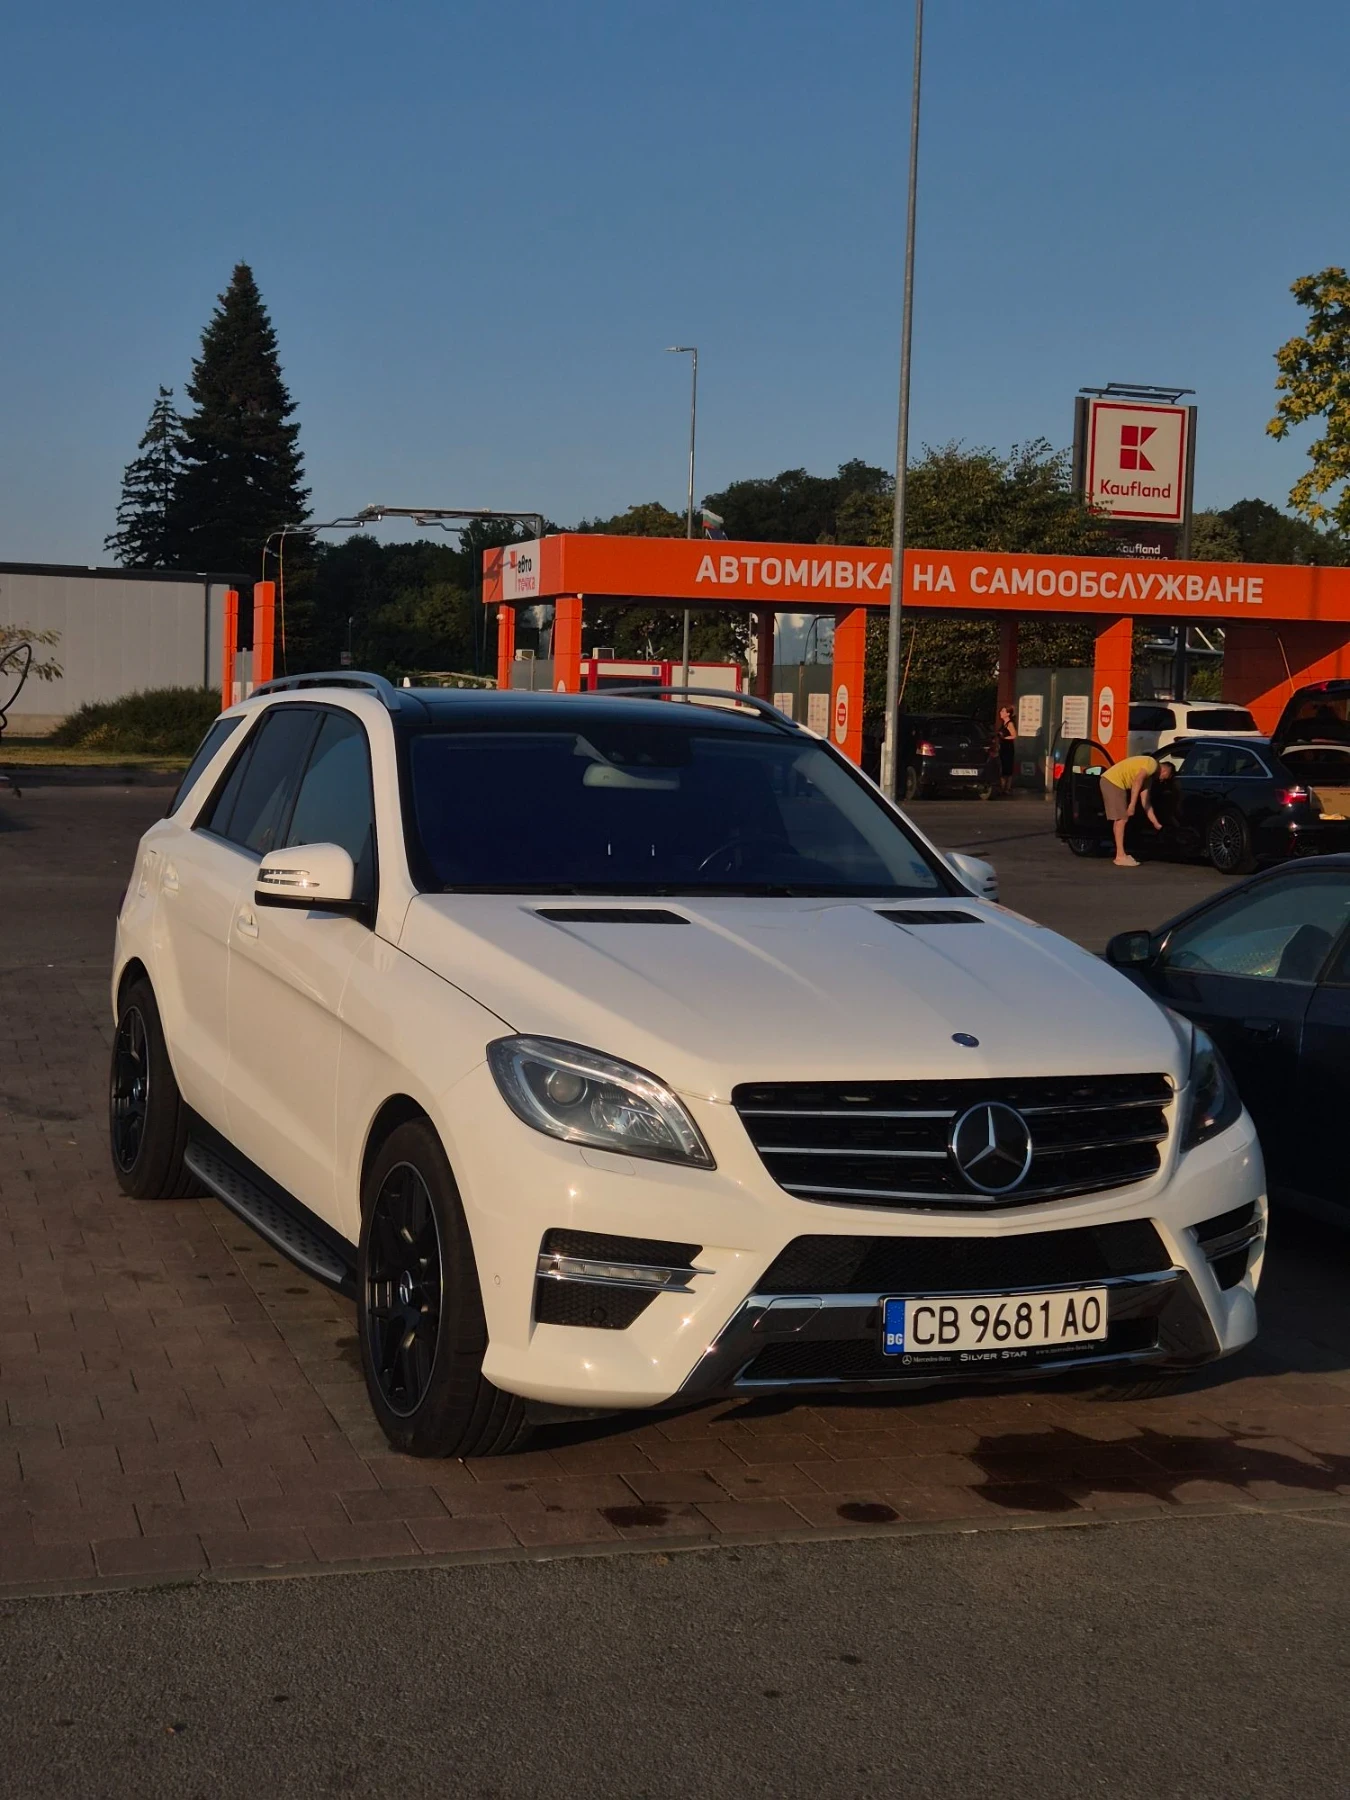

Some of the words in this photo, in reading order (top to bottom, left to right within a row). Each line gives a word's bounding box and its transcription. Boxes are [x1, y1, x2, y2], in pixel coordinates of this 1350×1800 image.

[1100, 479, 1171, 498] Kaufland
[695, 555, 894, 590] АВТОМИВКА
[912, 564, 956, 592] НА
[970, 566, 1263, 604] САМООБСЛУЖВАНЕ
[912, 1306, 960, 1345] CB
[970, 1300, 1050, 1343] 9681
[886, 1333, 903, 1346] BG
